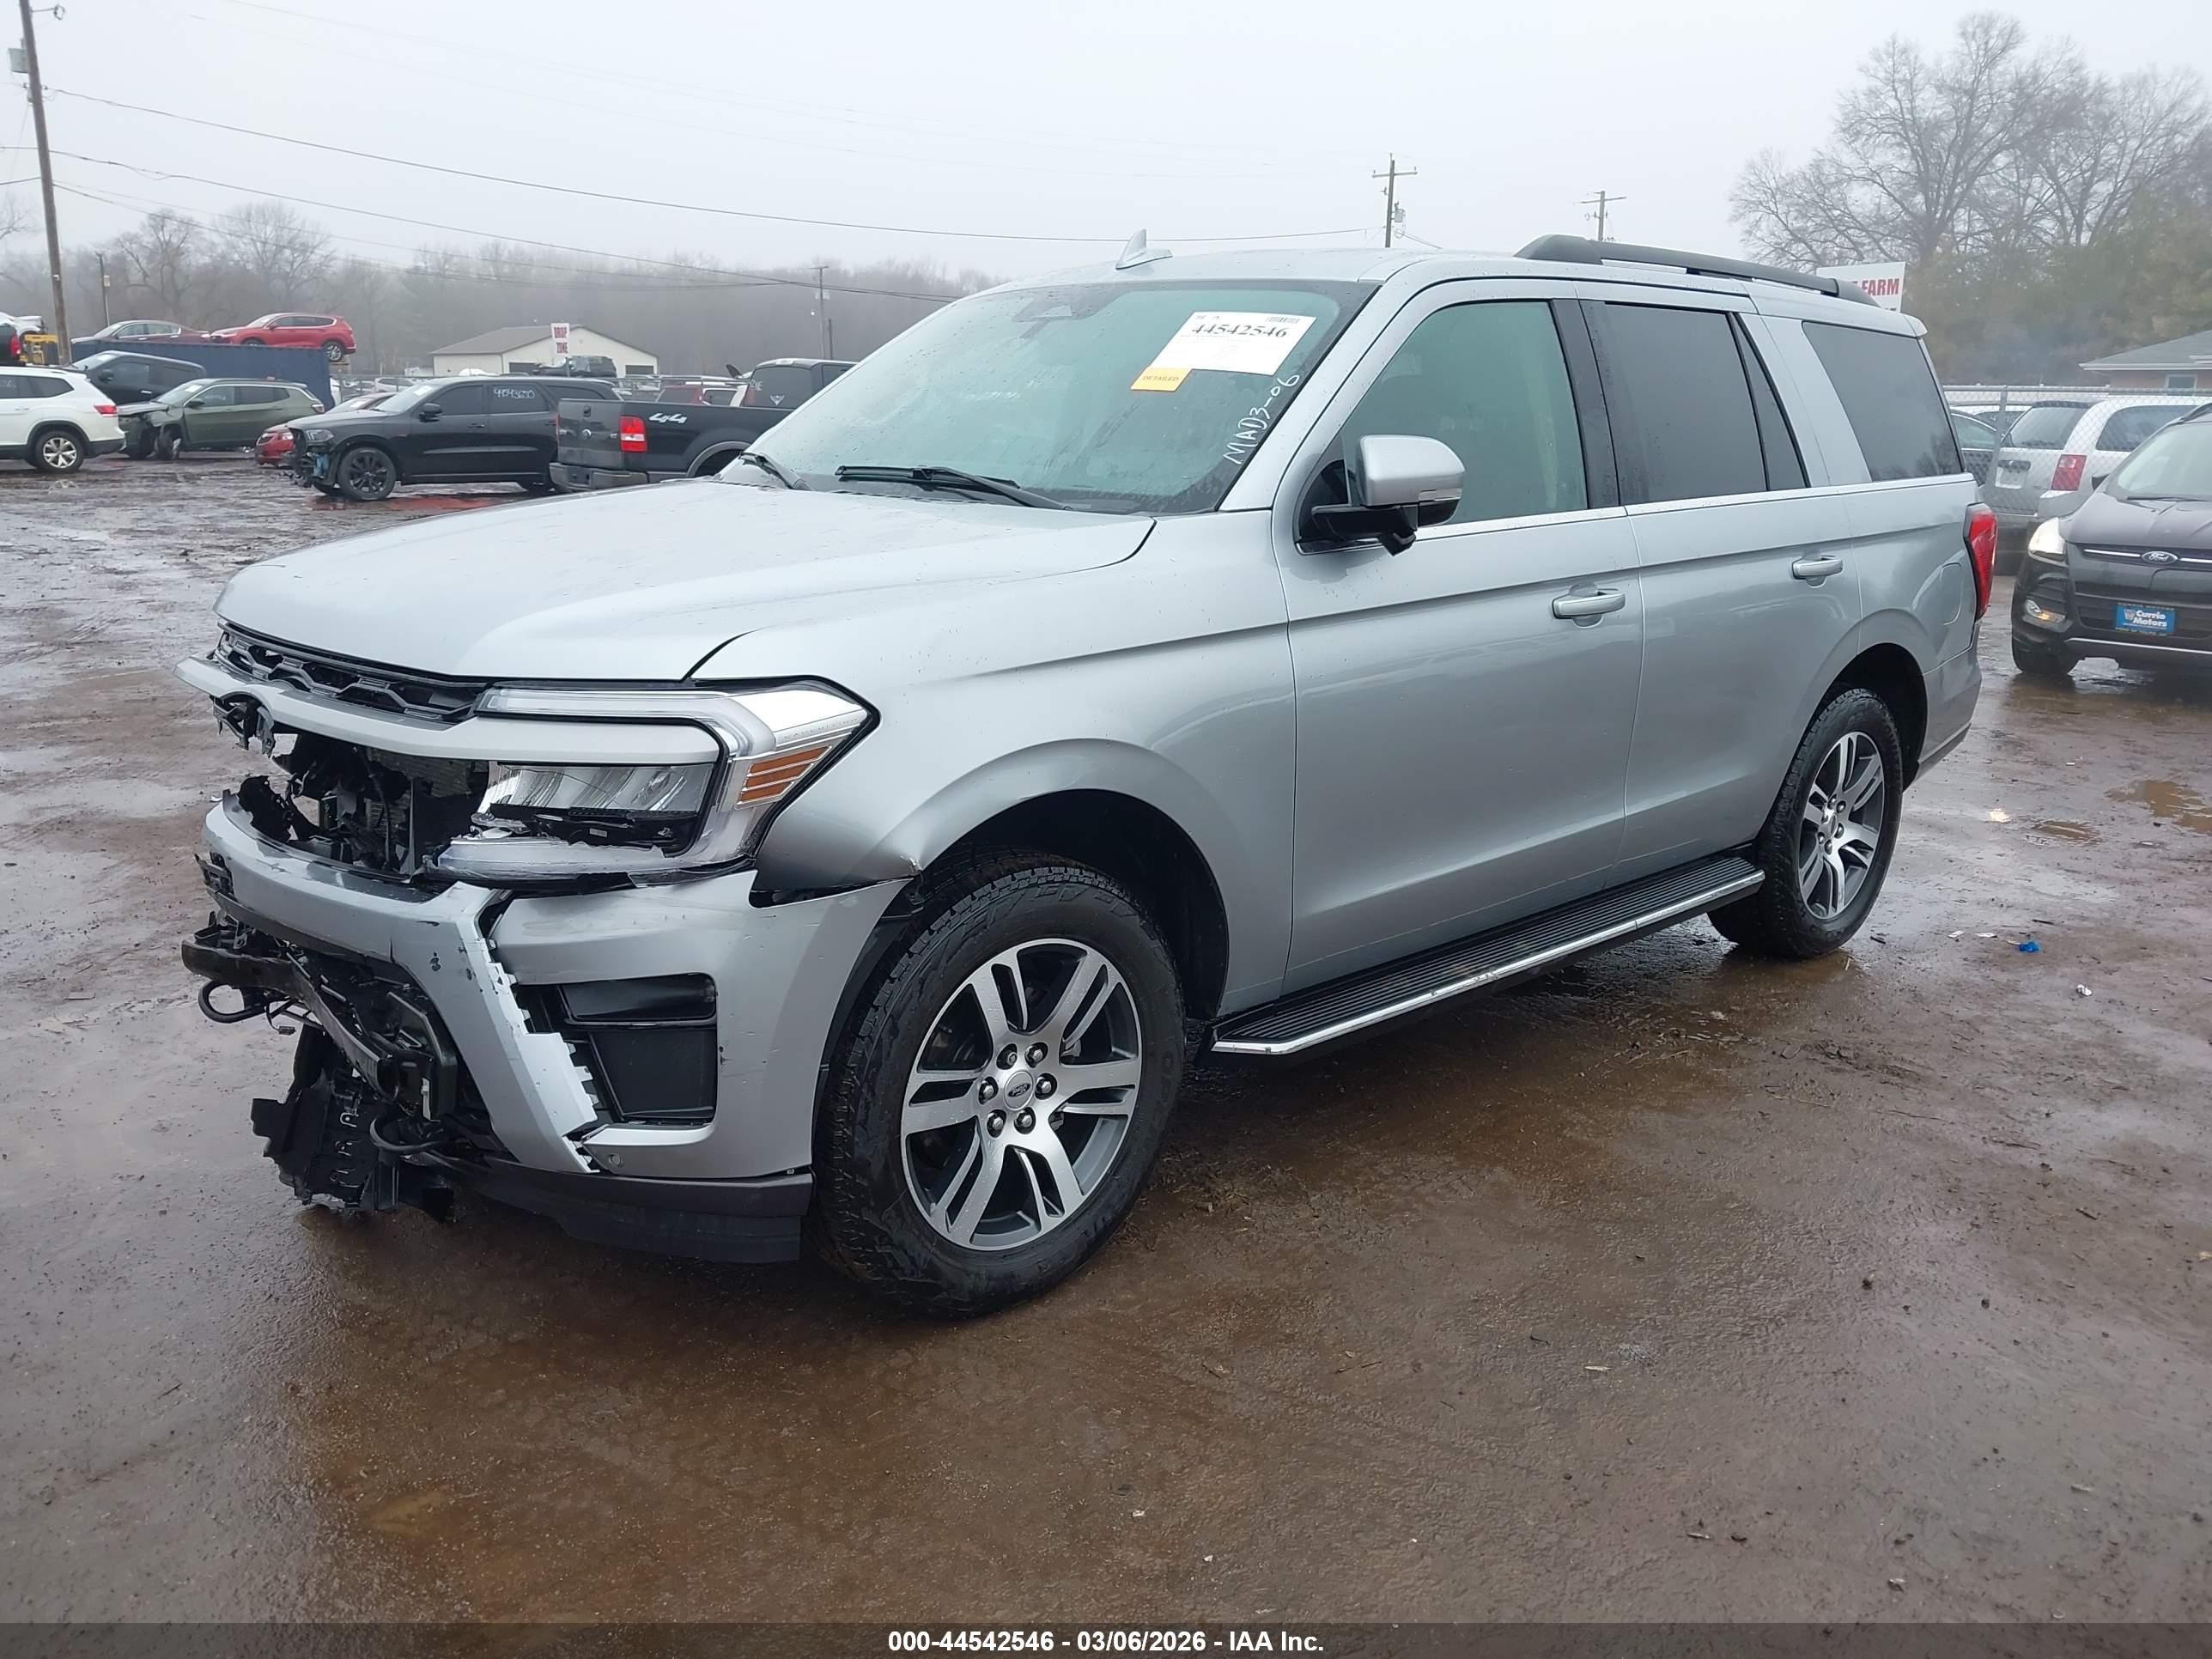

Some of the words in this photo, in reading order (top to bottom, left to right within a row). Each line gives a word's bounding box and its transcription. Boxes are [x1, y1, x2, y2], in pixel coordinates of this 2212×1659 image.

[1861, 277, 1900, 296] FARM
[1192, 323, 1289, 338] 44542546
[2148, 552, 2172, 562] Ford
[2133, 617, 2168, 628] Motors
